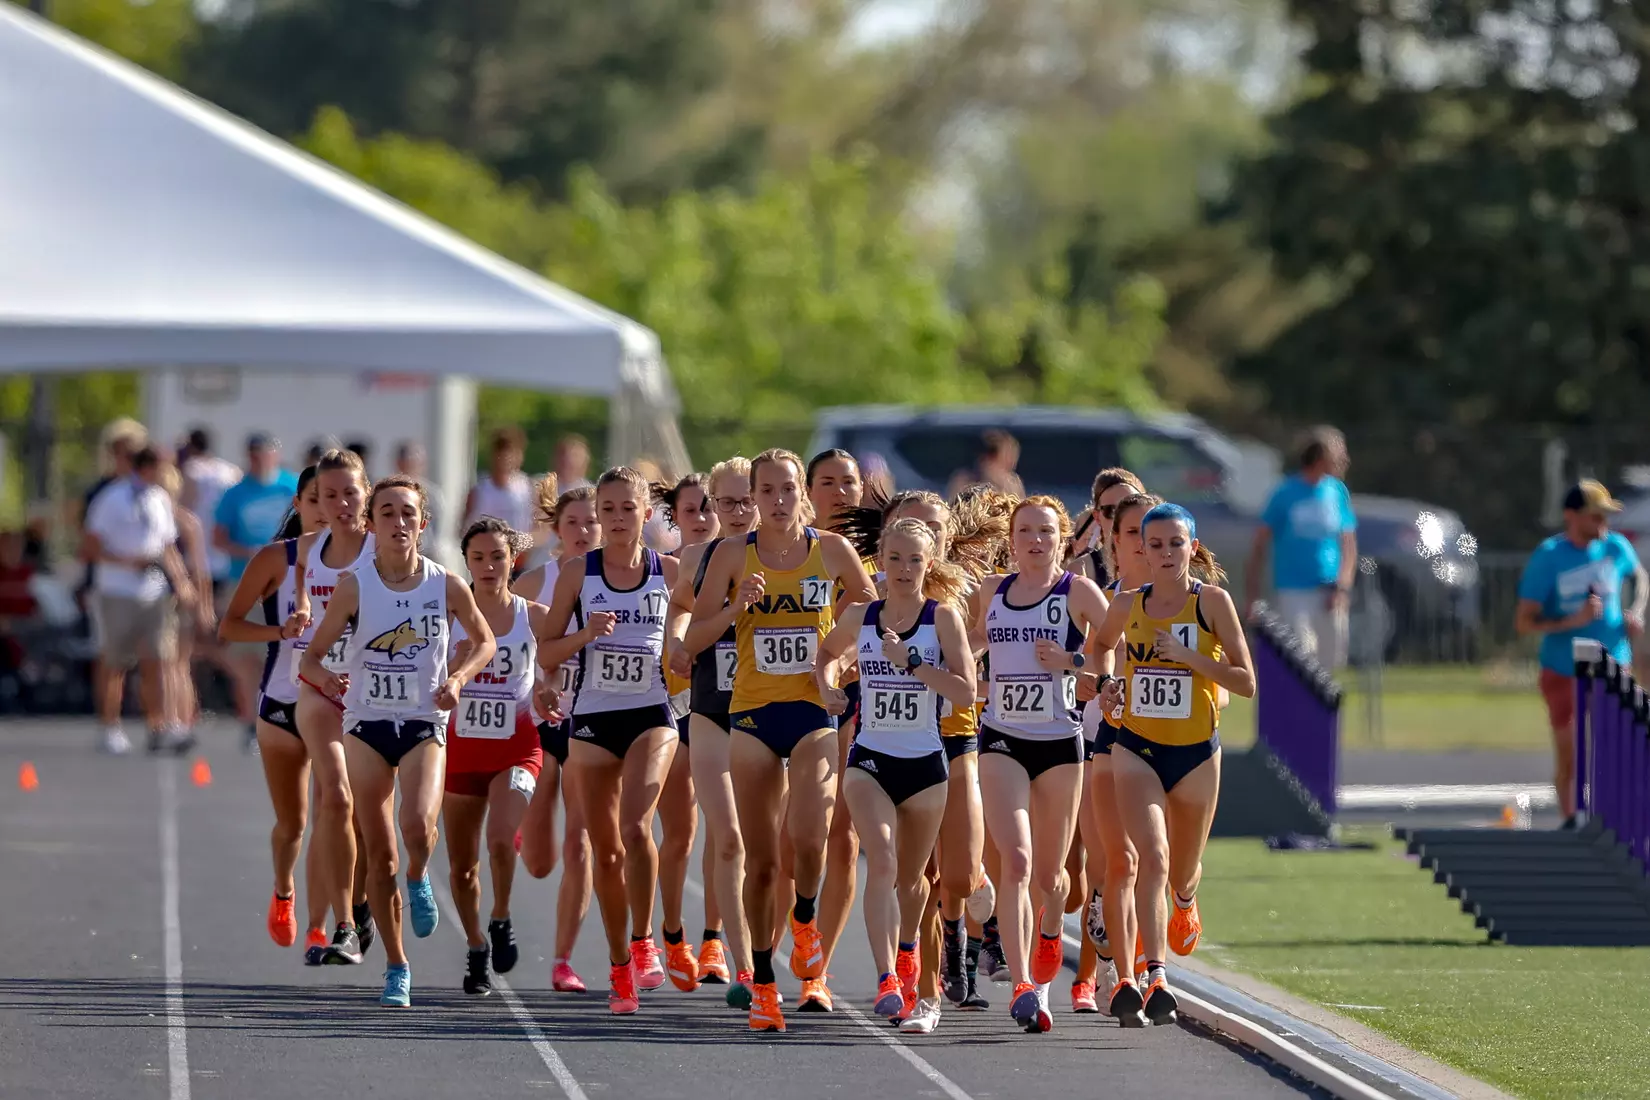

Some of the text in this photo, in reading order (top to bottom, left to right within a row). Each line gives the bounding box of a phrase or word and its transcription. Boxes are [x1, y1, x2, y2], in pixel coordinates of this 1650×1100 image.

[643, 593, 662, 615] 17
[809, 582, 827, 605] 21
[1046, 597, 1062, 625] 6
[421, 614, 441, 637] 15
[987, 627, 1059, 643] WEBER STATE
[1178, 625, 1189, 649] 1
[763, 636, 808, 664] 366
[601, 654, 644, 683] 533
[859, 660, 896, 676] WEBER
[369, 672, 408, 701] 311
[1002, 684, 1044, 712] 522
[1066, 677, 1075, 708] 6
[1139, 676, 1182, 707] 363
[465, 700, 507, 728] 469
[874, 691, 918, 720] 545
